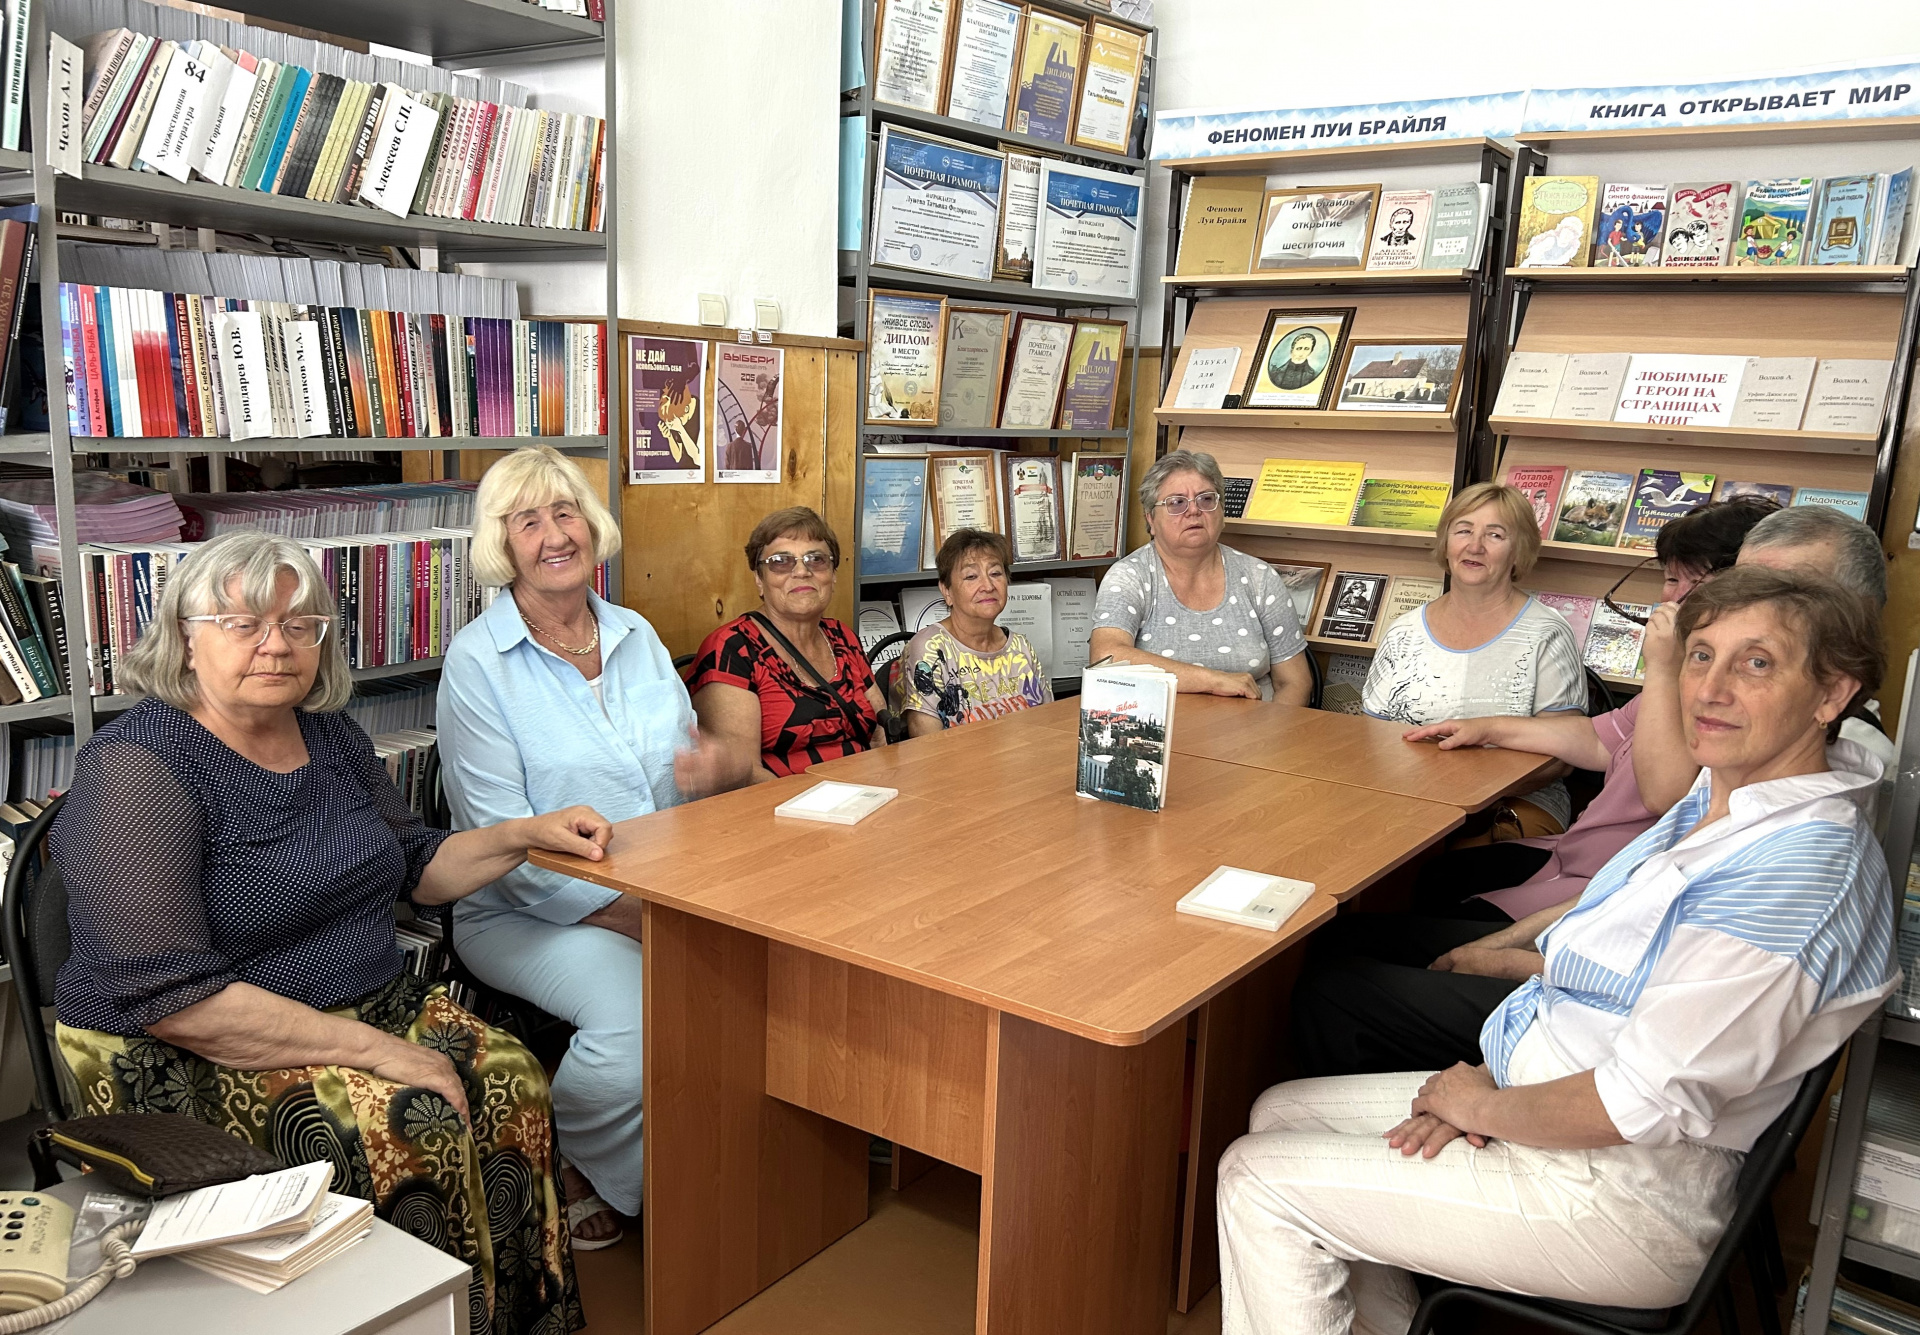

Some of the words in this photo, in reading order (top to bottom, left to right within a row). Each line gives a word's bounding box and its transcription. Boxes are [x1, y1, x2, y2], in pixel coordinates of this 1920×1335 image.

[62, 57, 71, 74] П.
[88, 73, 111, 110] РАССКАЗЫ
[110, 35, 131, 69] ПОВЕСТИ
[185, 62, 206, 83] 84
[1045, 67, 1073, 80] ДИПЛОМ
[61, 80, 71, 93] А.
[246, 78, 269, 123] ДЕТСТВО
[1590, 103, 1667, 119] КНИГА
[1678, 89, 1835, 115] ОТКРЫВАЕТ
[1848, 83, 1911, 105] МИР
[59, 103, 70, 152] Чехов
[157, 88, 187, 161] Художественная
[174, 106, 195, 157] литература
[205, 145, 214, 158] М.
[213, 106, 226, 145] Горький
[356, 128, 371, 159] ДЕРСУ
[365, 98, 382, 131] УЗАЛА
[440, 104, 460, 159] солдаты
[449, 105, 468, 160] солдаты
[457, 106, 477, 161] солдаты
[1208, 125, 1305, 145] ФЕНОМЕН
[1310, 122, 1352, 139] ЛУИ
[1358, 116, 1447, 136] БРАЙЛЯ
[374, 135, 401, 197] Алексеев
[395, 105, 413, 132] С.П.
[538, 155, 548, 181] ВОКРУГ
[545, 117, 555, 142] ОКОЛО
[546, 157, 556, 182] ВОКРУГ
[553, 119, 562, 144] ОКОЛО
[904, 165, 946, 182] ПОЧЕТНАЯ
[947, 175, 981, 191] ГРАМОТА
[1061, 198, 1094, 210] ПОЧЕТНАЯ
[1095, 202, 1123, 215] ГРАМОТА
[1292, 198, 1313, 210] Луи
[1768, 189, 1809, 198] высочество!
[1206, 205, 1243, 214] Феномен
[1217, 216, 1247, 226] Брайля
[1292, 219, 1343, 231] открытие
[1282, 239, 1345, 251] шеститочия
[175, 299, 186, 314] БОЙ
[192, 298, 201, 326] яблока
[179, 321, 190, 349] УХОДЯТ
[194, 327, 204, 340] три
[231, 326, 243, 359] Ю.В.
[320, 312, 331, 349] Маргарита
[332, 314, 342, 349] РАЗВЕДКИ
[884, 333, 930, 346] ДИПЛОМ
[72, 327, 84, 379] ЦАРЬ-РЫБА
[87, 328, 99, 379] ЦАРЬ-РЫБА
[197, 342, 206, 364] упали
[295, 332, 305, 361] М.А.
[636, 350, 646, 361] НЕ
[648, 349, 665, 363] ДАЙ
[724, 353, 774, 364] ВЫБЕРИ
[182, 350, 194, 384] СЫНОВЬЯ
[337, 350, 346, 379] ЗАКОНЫ
[1635, 371, 1728, 384] ЛЮБИМЫЕ
[237, 363, 252, 423] Бондарев
[299, 364, 313, 422] Булгаков
[343, 386, 353, 421] Бортников
[1635, 385, 1691, 397] ГЕРОИ
[1693, 386, 1716, 398] НА
[204, 394, 214, 423] Абгарян
[1620, 399, 1722, 413] СТРАНИЦАХ
[1647, 414, 1694, 426] КНИГ
[636, 437, 651, 448] НЕТ
[1514, 473, 1555, 482] Потапов,
[1521, 480, 1552, 489] доске!
[1081, 490, 1113, 500] ГРАМОТА
[1803, 494, 1860, 507] Недопесок
[46, 588, 60, 620] ЗАМОК
[89, 592, 98, 643] Волоколамское
[99, 593, 108, 644] Волоколамское
[54, 625, 68, 656] КАФКА
[4, 650, 23, 675] ЛЕГЕНДЫ
[24, 645, 41, 669] КУТЗЕЕ
